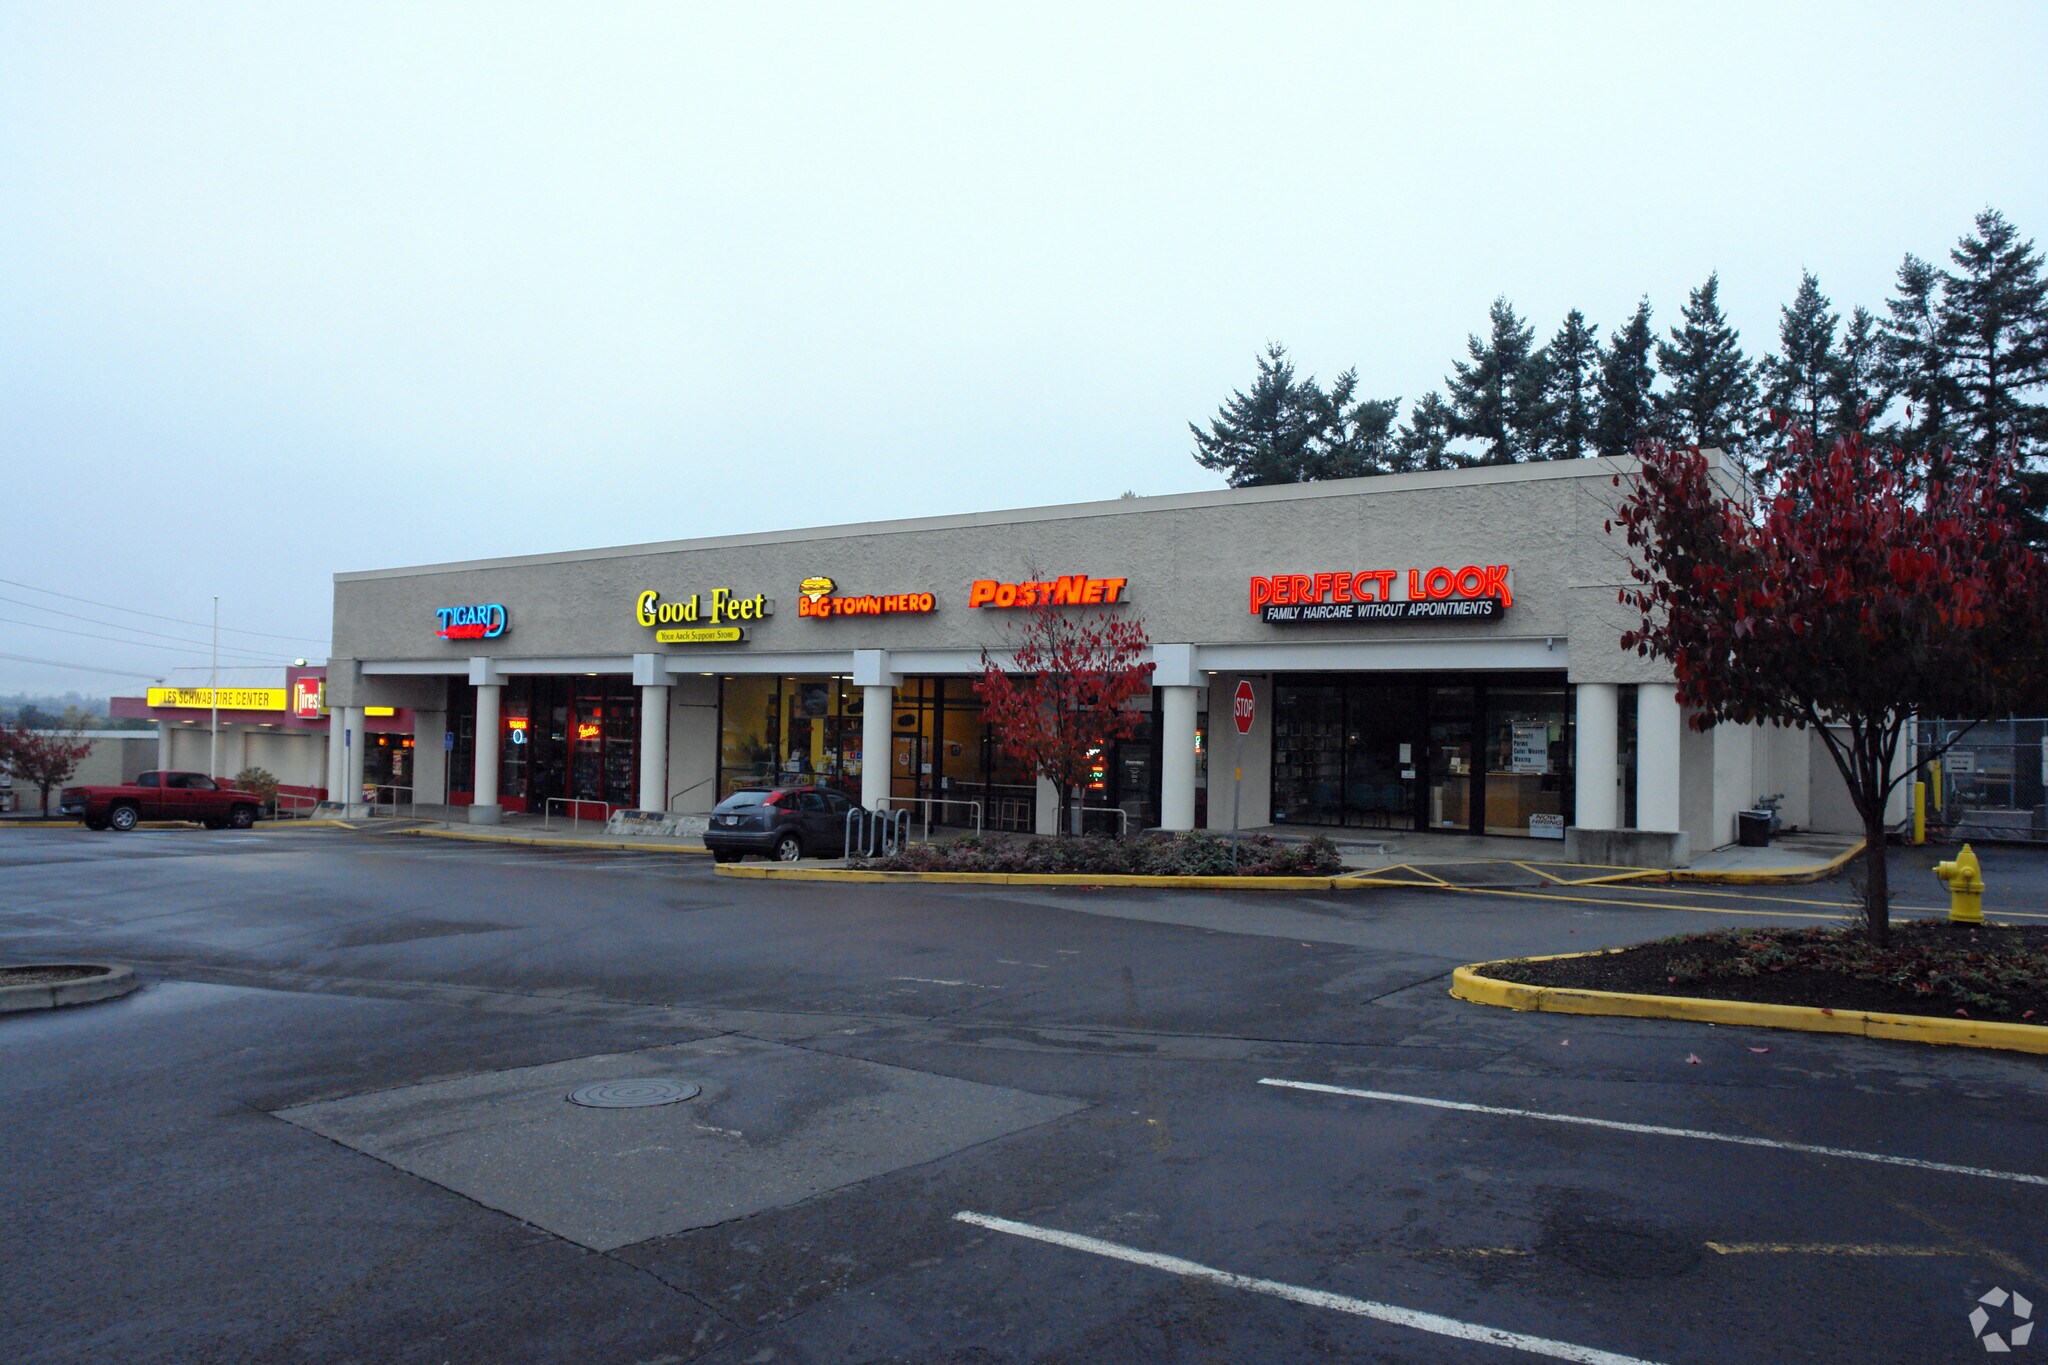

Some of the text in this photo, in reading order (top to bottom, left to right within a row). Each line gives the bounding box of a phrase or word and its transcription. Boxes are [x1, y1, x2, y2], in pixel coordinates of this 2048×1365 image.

[1250, 565, 1512, 614] PERFECT LOOK
[637, 588, 764, 627] Good Feet
[832, 594, 881, 615] TOWN
[884, 592, 934, 612] HERO
[1267, 601, 1493, 620] FAMILY HAIRCARE WITHOUT APPOINTMENTS
[436, 603, 506, 640] TIGARD
[163, 690, 269, 707] LES SCHWAB TIRE CENTER
[1235, 697, 1253, 717] STOP
